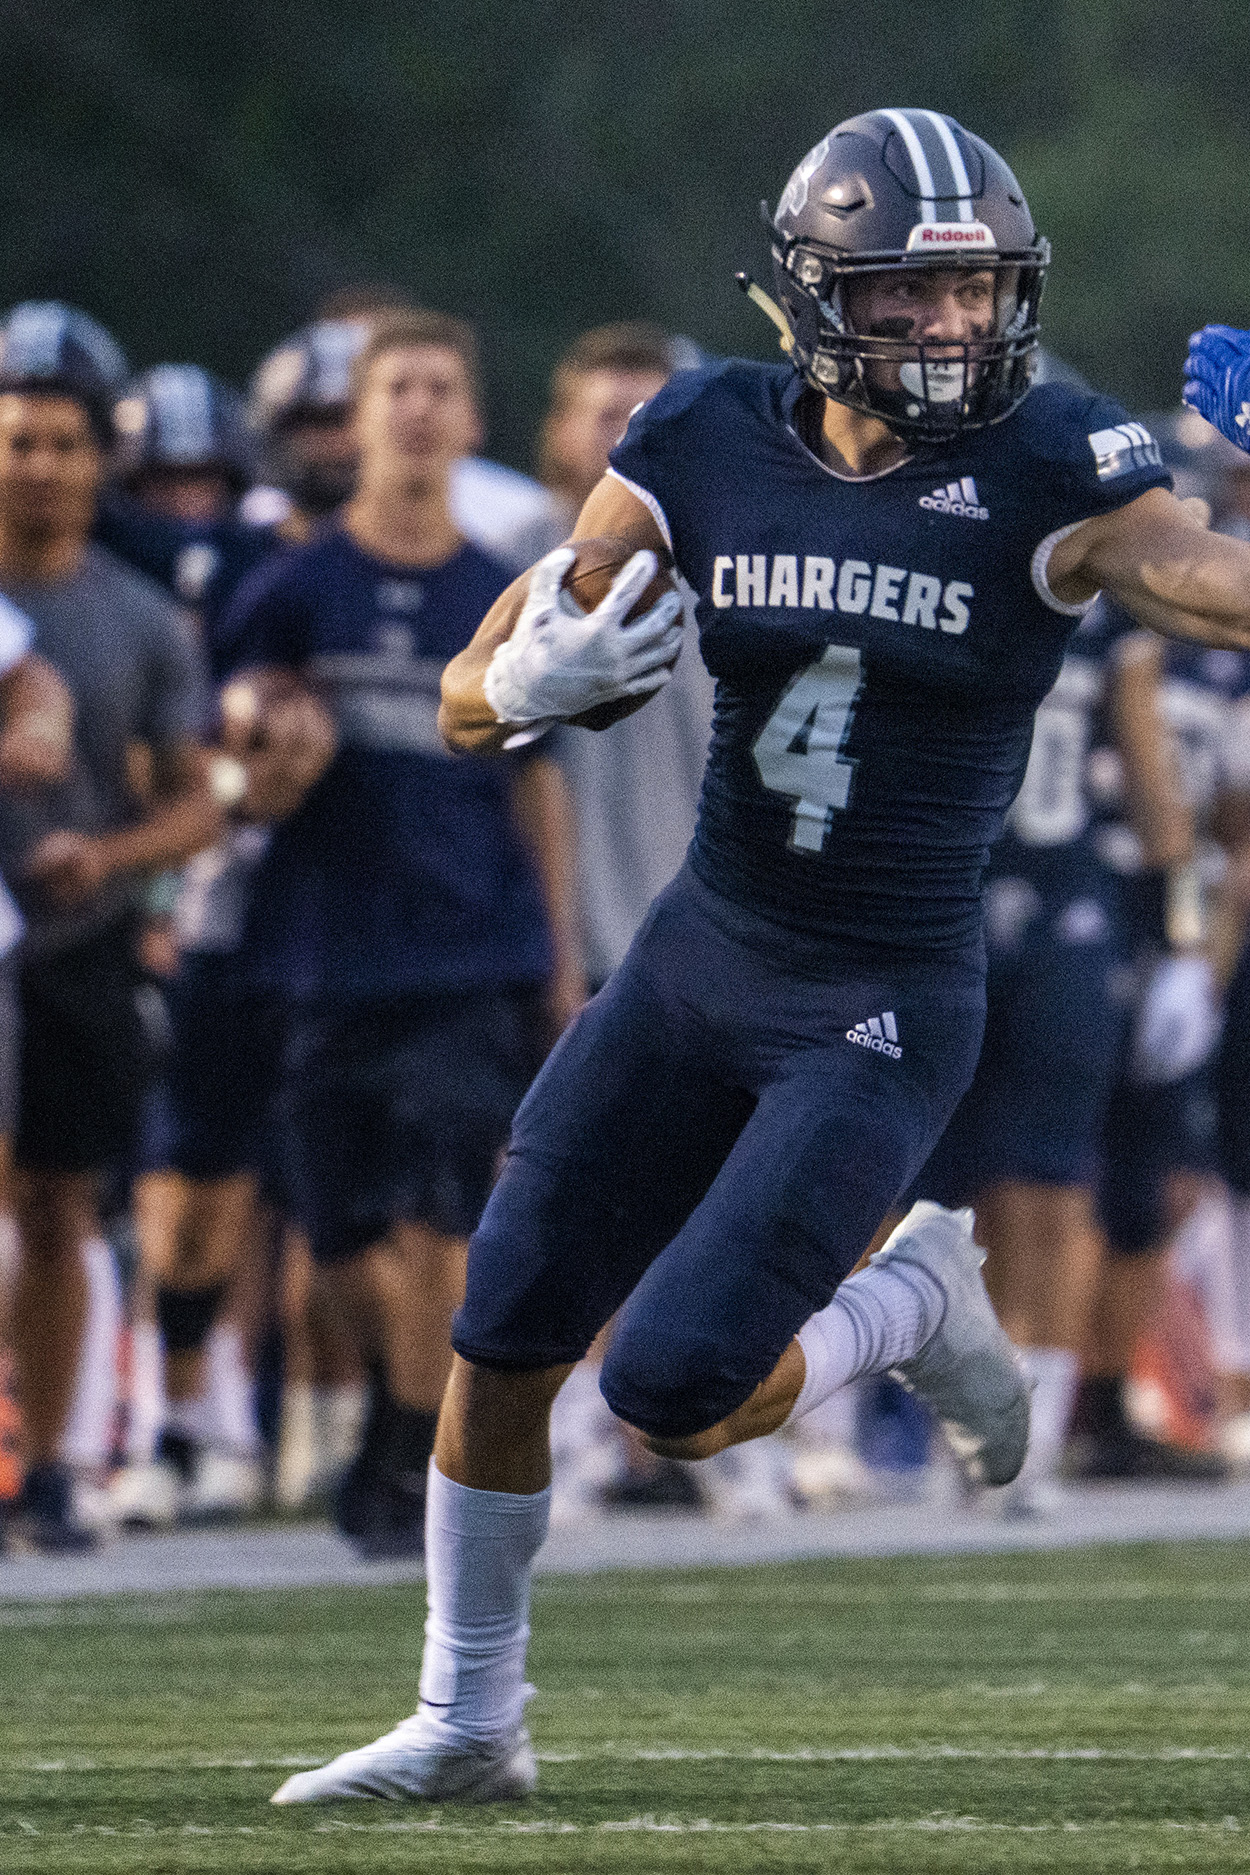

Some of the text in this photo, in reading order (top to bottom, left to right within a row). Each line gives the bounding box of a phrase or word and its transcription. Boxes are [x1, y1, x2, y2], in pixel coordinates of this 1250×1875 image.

[921, 229, 986, 241] Riddell
[919, 496, 989, 520] adidas
[712, 554, 974, 635] CHARGERS
[752, 643, 867, 852] 4
[845, 1029, 903, 1059] adidas
